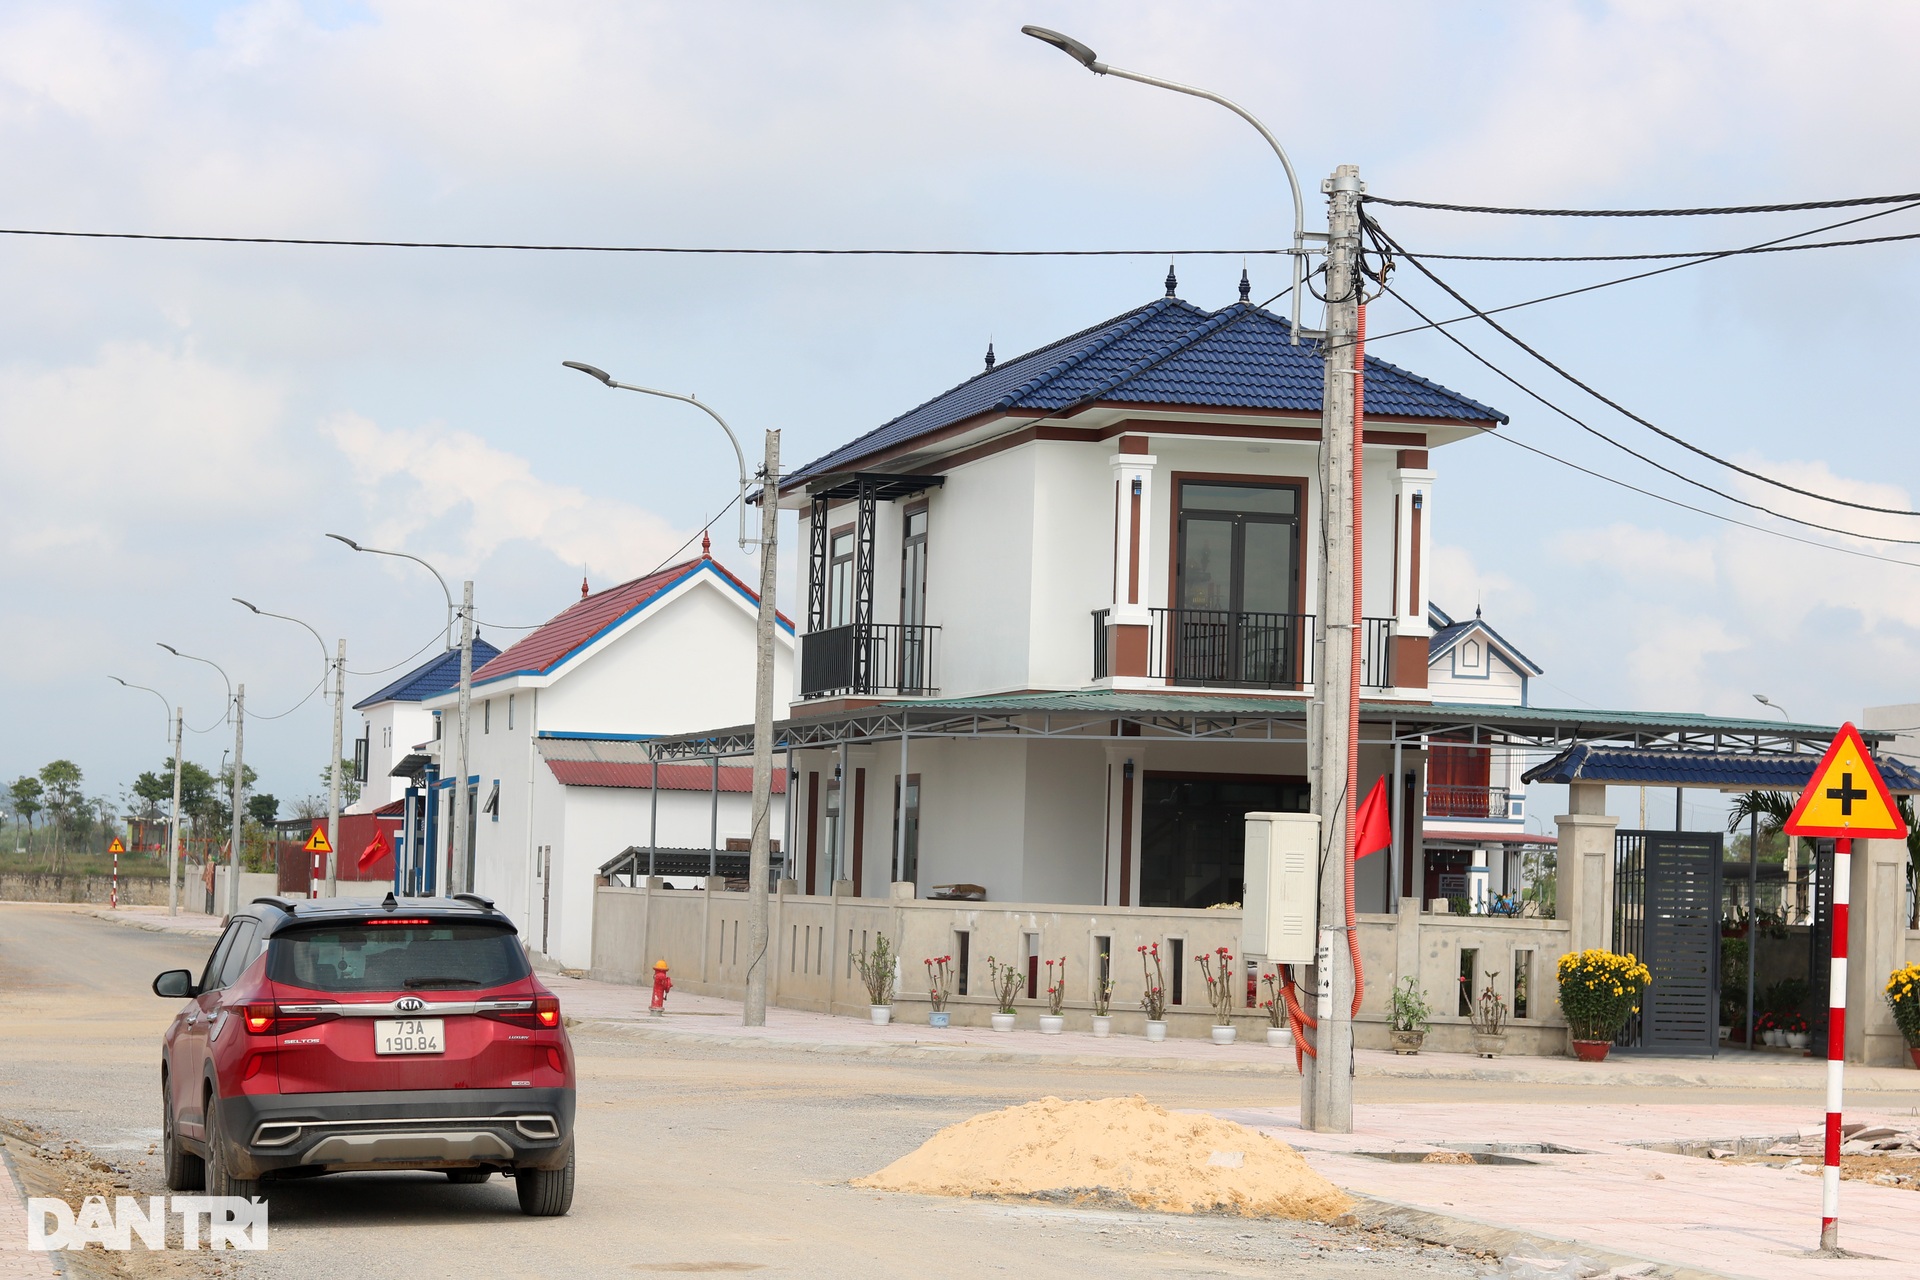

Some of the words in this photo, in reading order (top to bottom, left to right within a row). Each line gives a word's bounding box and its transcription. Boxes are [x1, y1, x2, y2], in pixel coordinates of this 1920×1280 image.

[400, 1000, 420, 1010] KIA
[395, 1021, 424, 1035] 73A
[385, 1036, 437, 1051] 190.84
